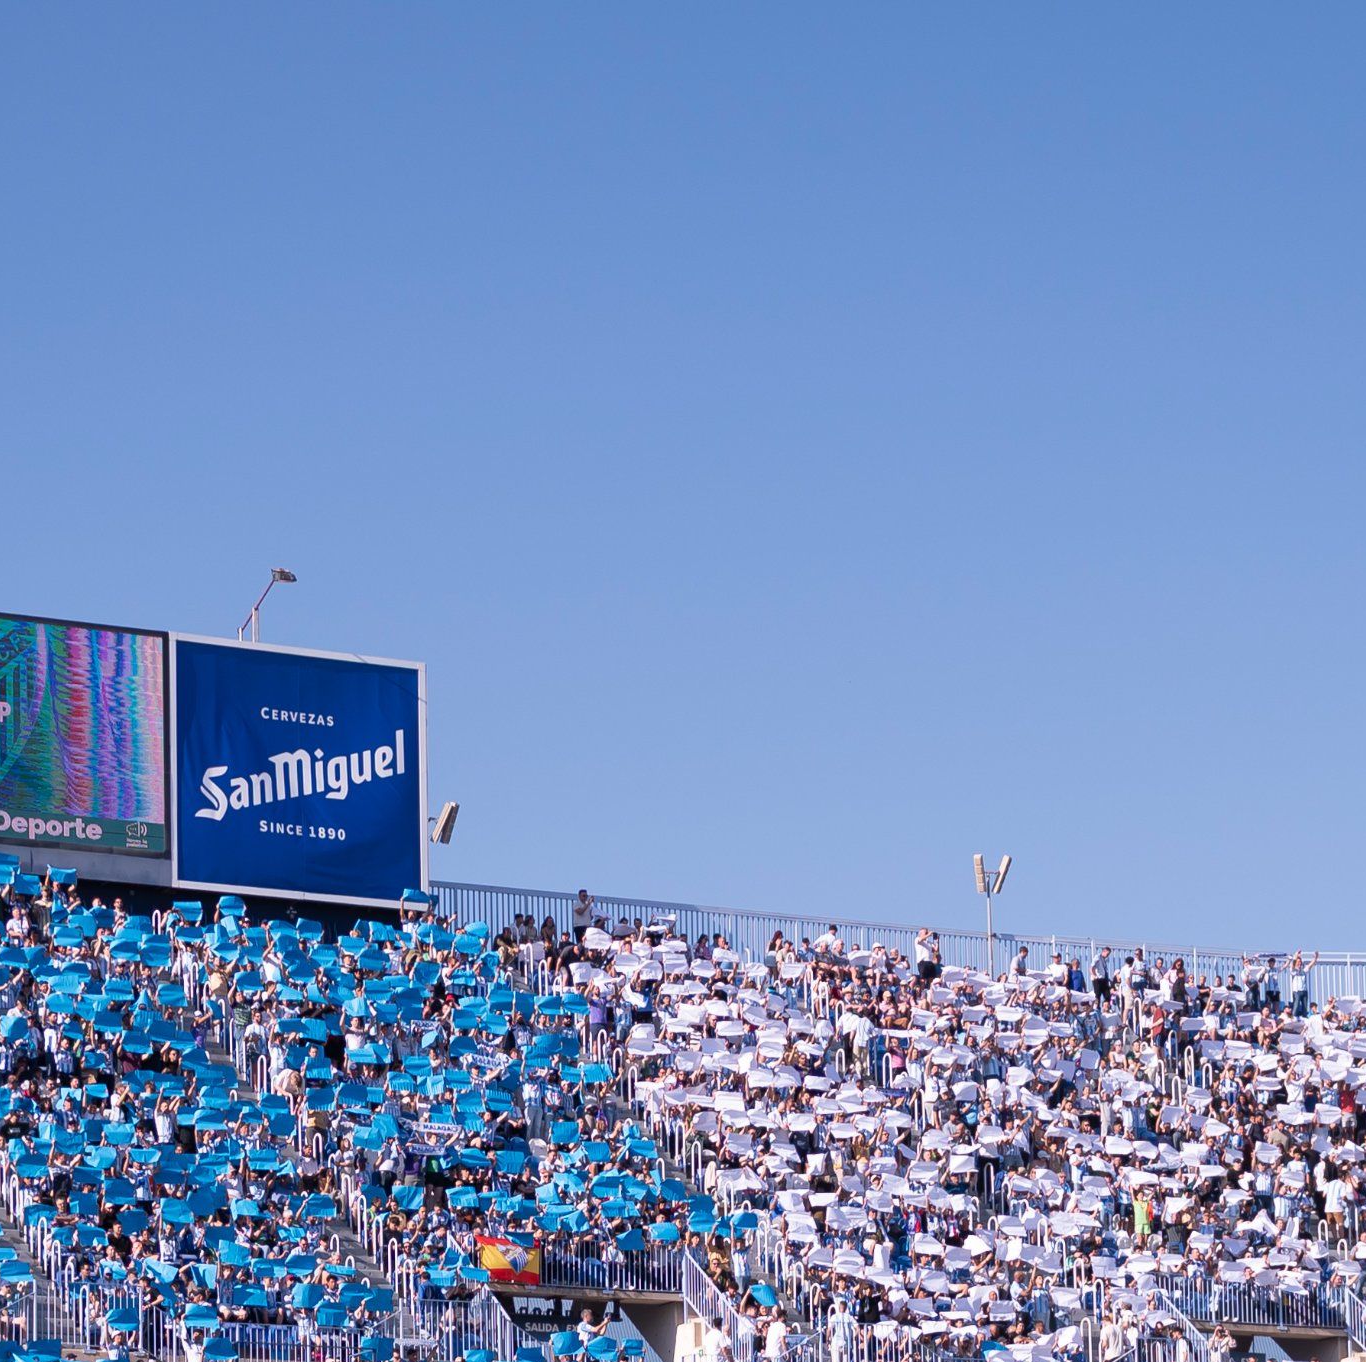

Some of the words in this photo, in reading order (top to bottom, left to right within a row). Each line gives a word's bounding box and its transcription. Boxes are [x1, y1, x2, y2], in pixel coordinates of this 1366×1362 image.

[260, 707, 335, 727] CERVEZAS
[194, 729, 405, 822] SanMiguel
[259, 820, 304, 837] SINCE
[308, 826, 346, 841] 1890
[525, 1323, 559, 1333] SALIDA
